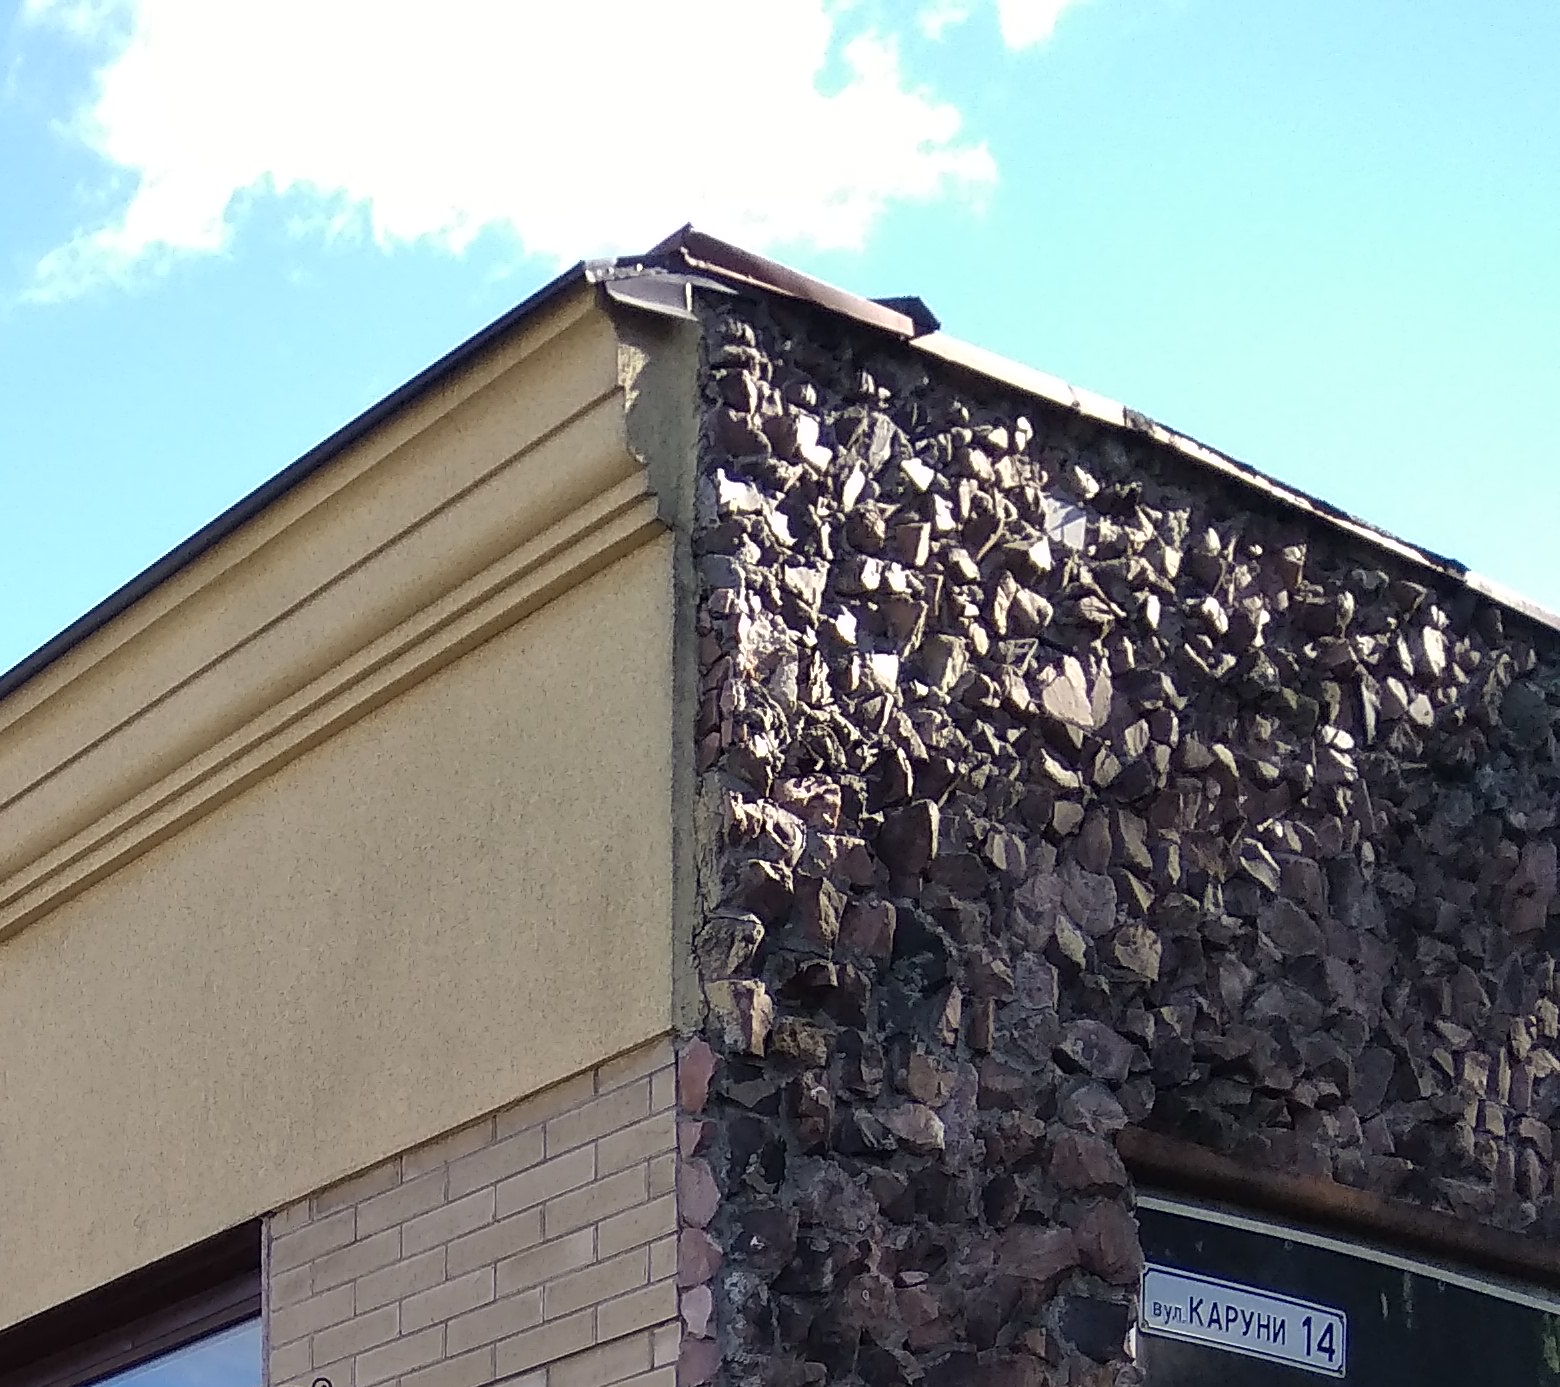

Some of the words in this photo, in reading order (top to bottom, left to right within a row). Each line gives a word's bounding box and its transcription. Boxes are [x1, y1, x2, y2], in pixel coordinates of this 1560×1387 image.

[1152, 1301, 1186, 1327] вул.
[1188, 1296, 1287, 1346] КАРУНИ
[1301, 1316, 1337, 1363] 14
